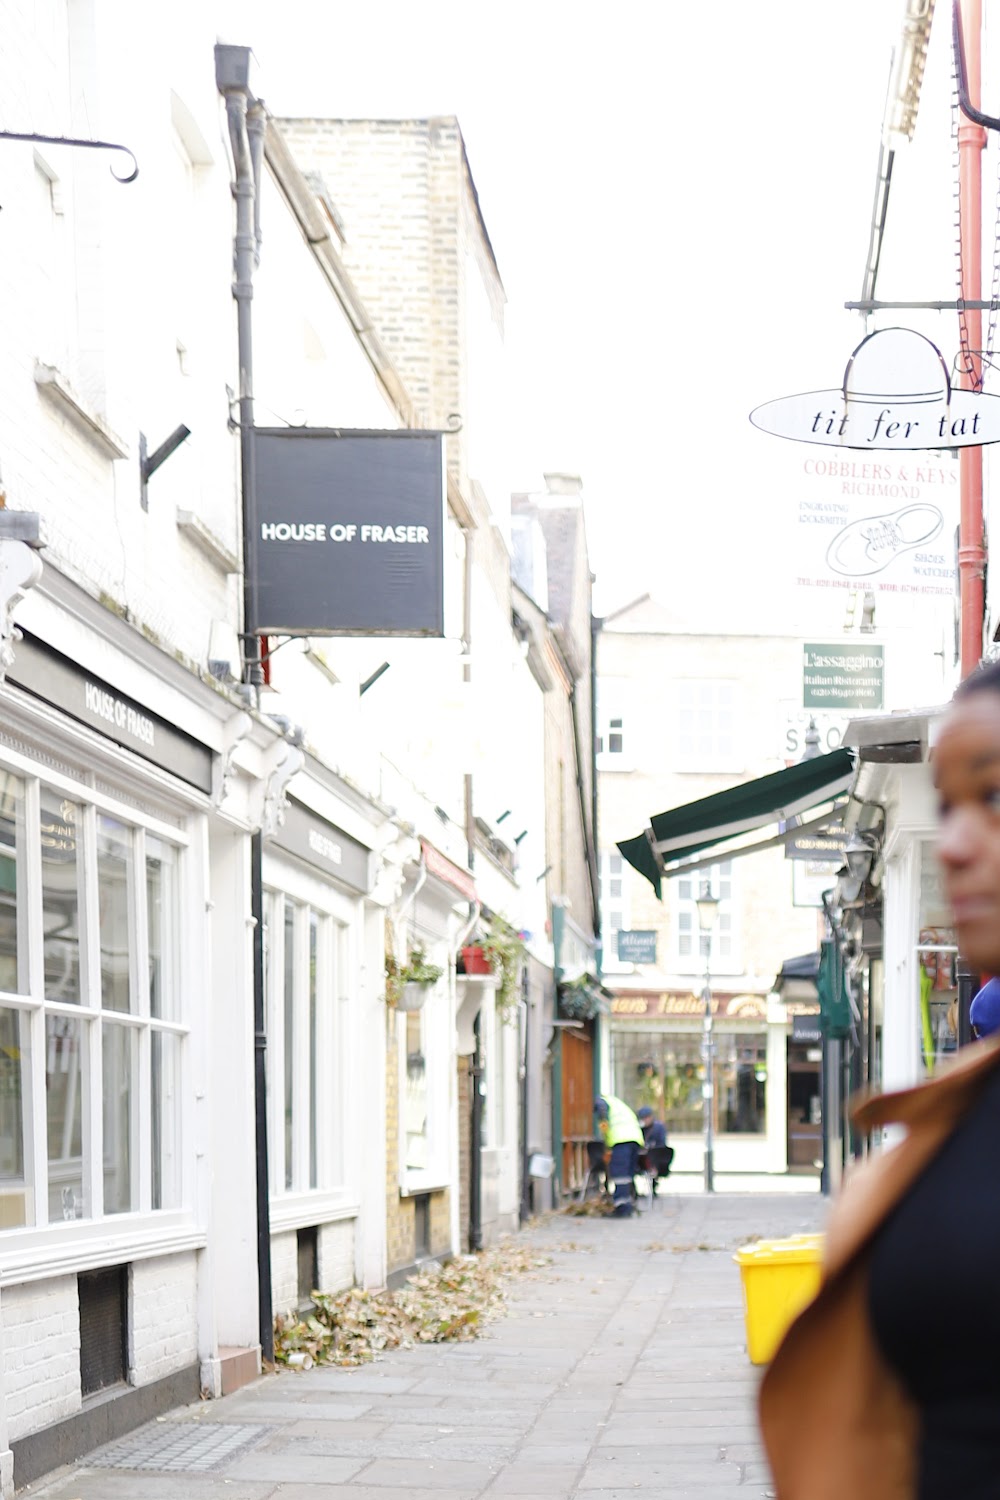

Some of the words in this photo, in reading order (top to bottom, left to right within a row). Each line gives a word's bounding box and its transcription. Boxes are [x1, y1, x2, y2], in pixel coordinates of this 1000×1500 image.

[811, 409, 849, 436] tit
[867, 409, 920, 442] fer
[938, 411, 982, 438] tat
[803, 458, 892, 480] COBBLERS
[897, 465, 909, 482] &
[916, 467, 958, 486] KEYS
[841, 481, 921, 499] RICHMOND
[261, 522, 327, 542] HOUSE
[329, 523, 358, 542] OF
[360, 524, 430, 543] FRASER
[914, 552, 946, 564] SHOES
[804, 674, 833, 685] Italian
[833, 675, 882, 687] Ristorante
[85, 681, 115, 723] HOUSE
[114, 699, 127, 729] OF
[127, 707, 155, 747] FRASER
